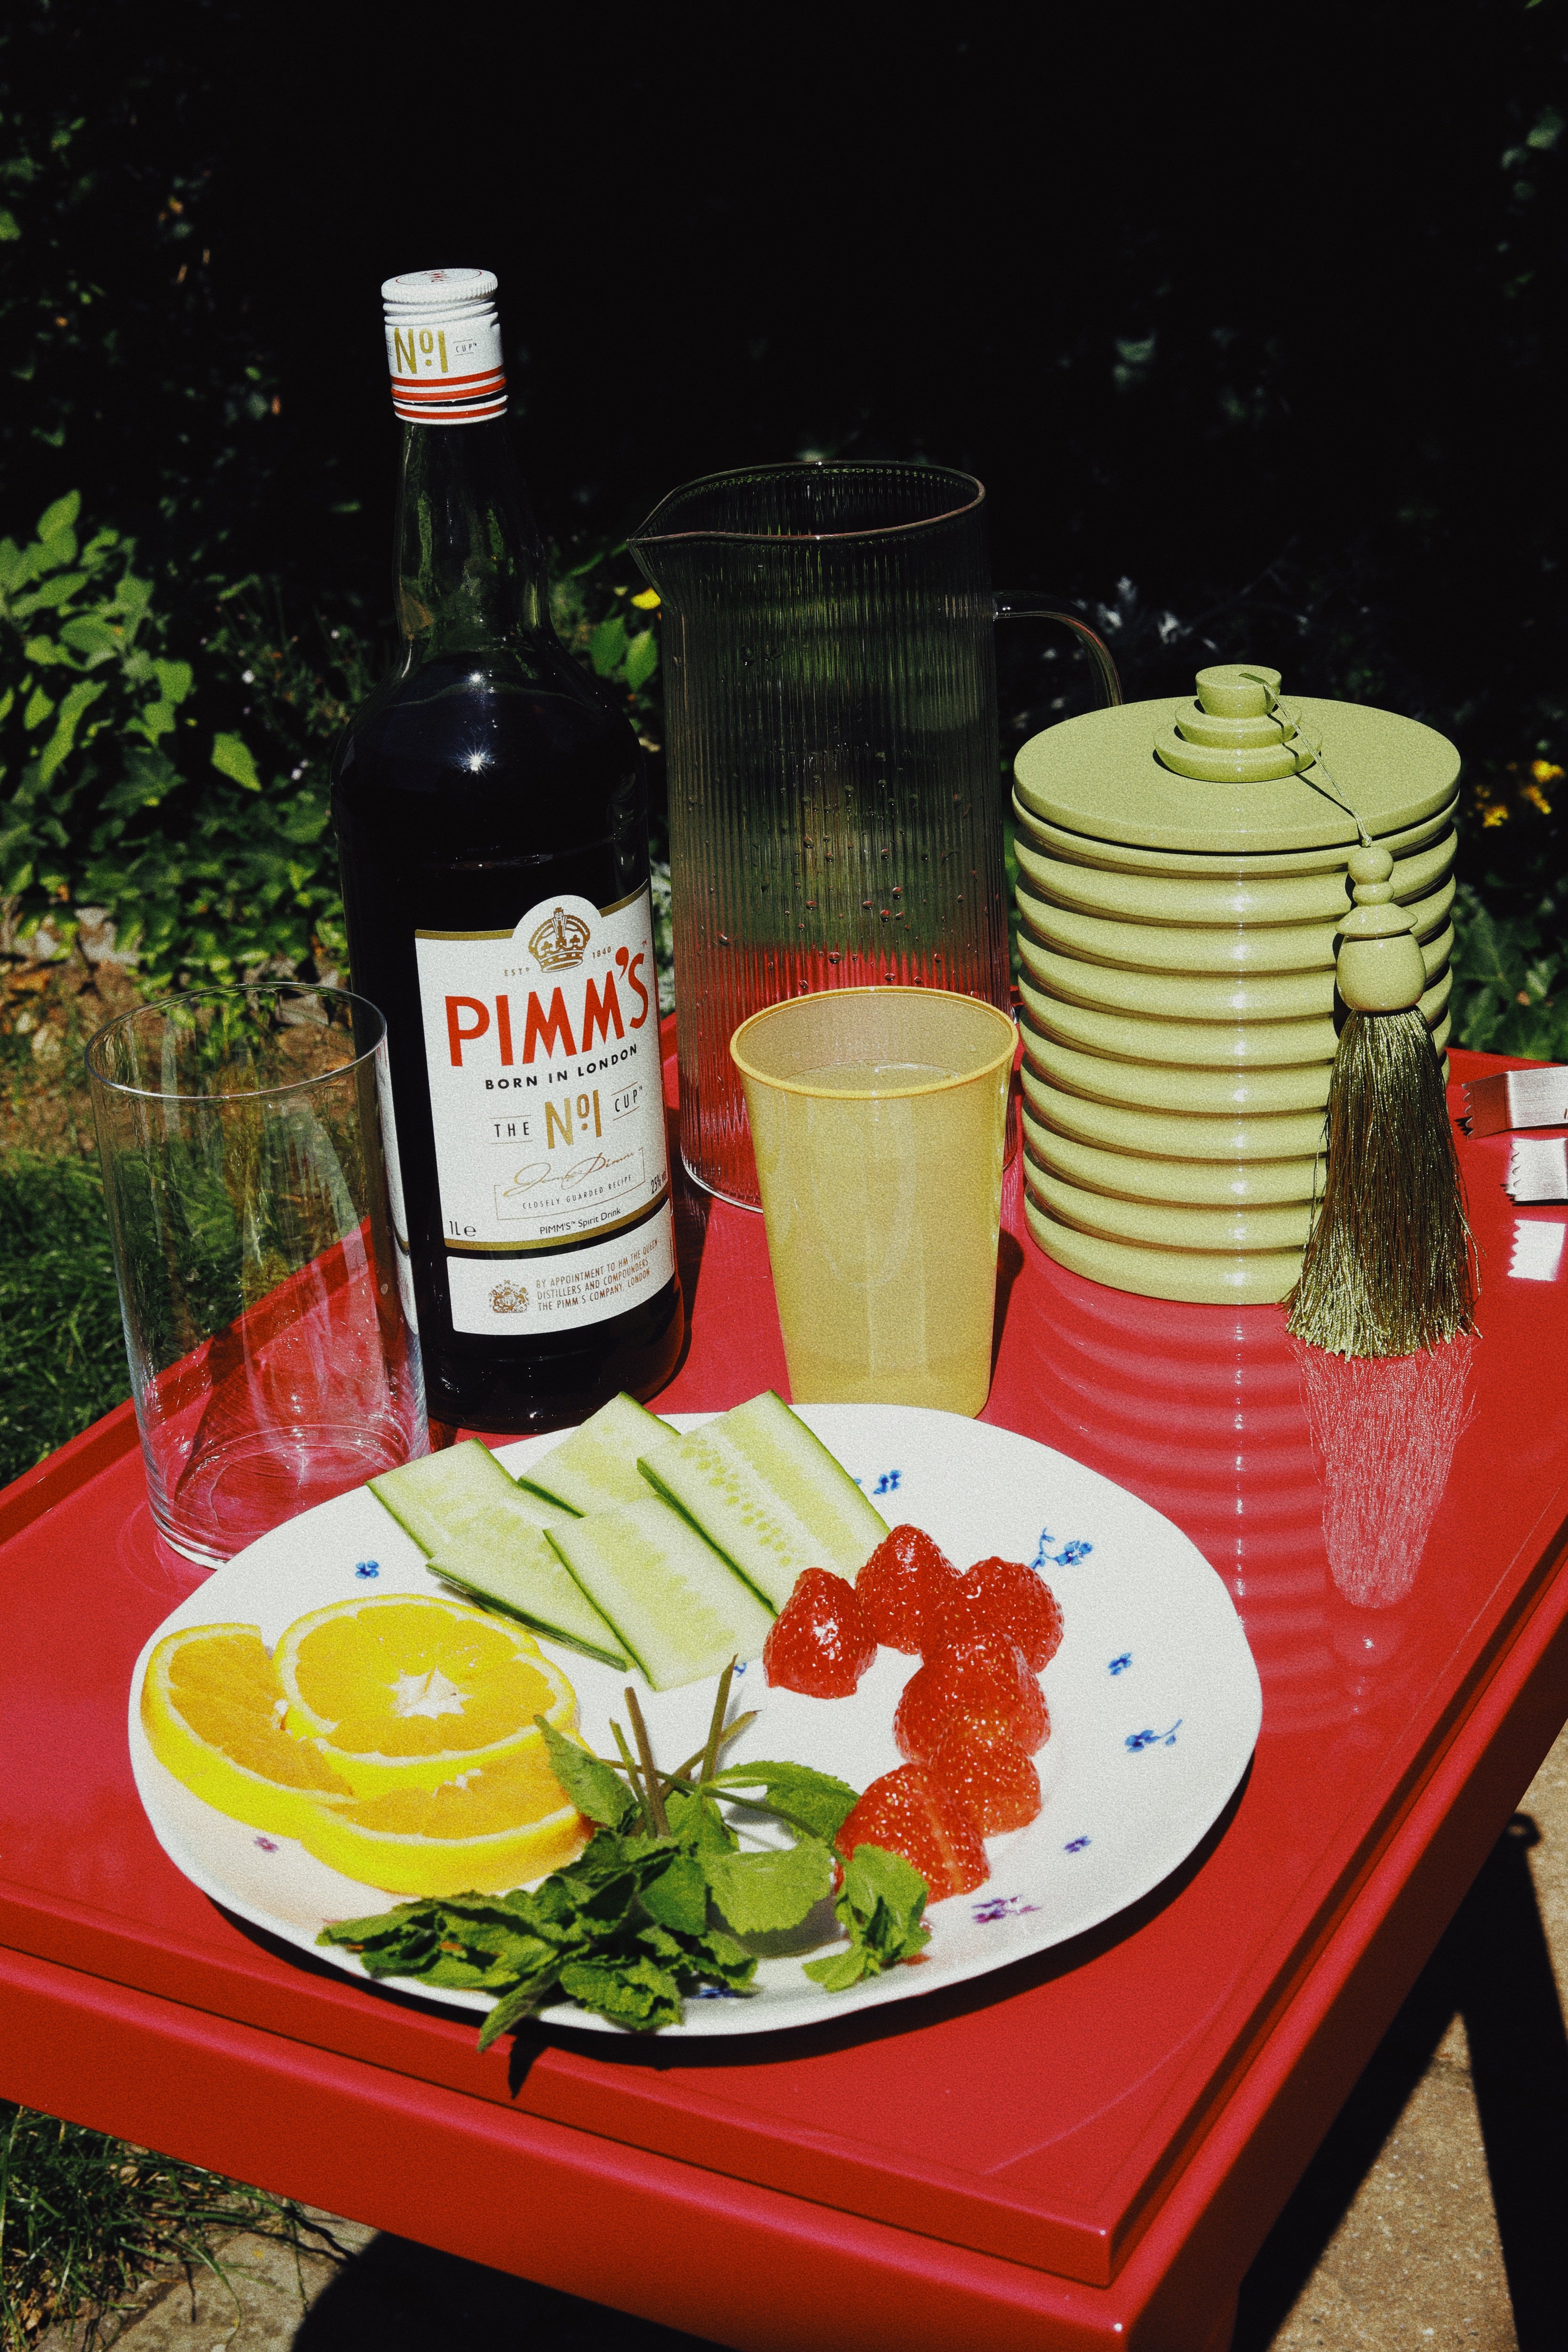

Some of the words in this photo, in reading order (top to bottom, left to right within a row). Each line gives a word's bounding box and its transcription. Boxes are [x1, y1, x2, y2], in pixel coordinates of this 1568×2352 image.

[592, 946, 612, 959] 1840
[486, 1076, 537, 1089] BORN
[549, 1071, 567, 1083] IN
[578, 1044, 637, 1077] LONDON
[494, 1121, 530, 1137] THE
[523, 1198, 560, 1209] CLOSELY
[566, 1186, 604, 1202] GUARDED
[608, 1174, 632, 1190] RECIPE
[651, 1173, 661, 1194] 25%
[449, 1220, 461, 1235] 1L
[578, 1216, 599, 1229] Spirit
[601, 1207, 621, 1221] Drink
[536, 1279, 546, 1288] BY
[550, 1266, 604, 1287] APPOINTMENT
[607, 1262, 615, 1273] TO
[618, 1256, 628, 1268] HM
[630, 1249, 641, 1262] THE
[643, 1238, 658, 1255] QUEEN
[537, 1285, 581, 1300] DISTILLERS
[585, 1279, 600, 1291] AND
[604, 1257, 649, 1286] COMPOUNDERS
[538, 1302, 553, 1311] THE
[557, 1295, 586, 1309] PIMM'S
[627, 1267, 650, 1287] LONDON
